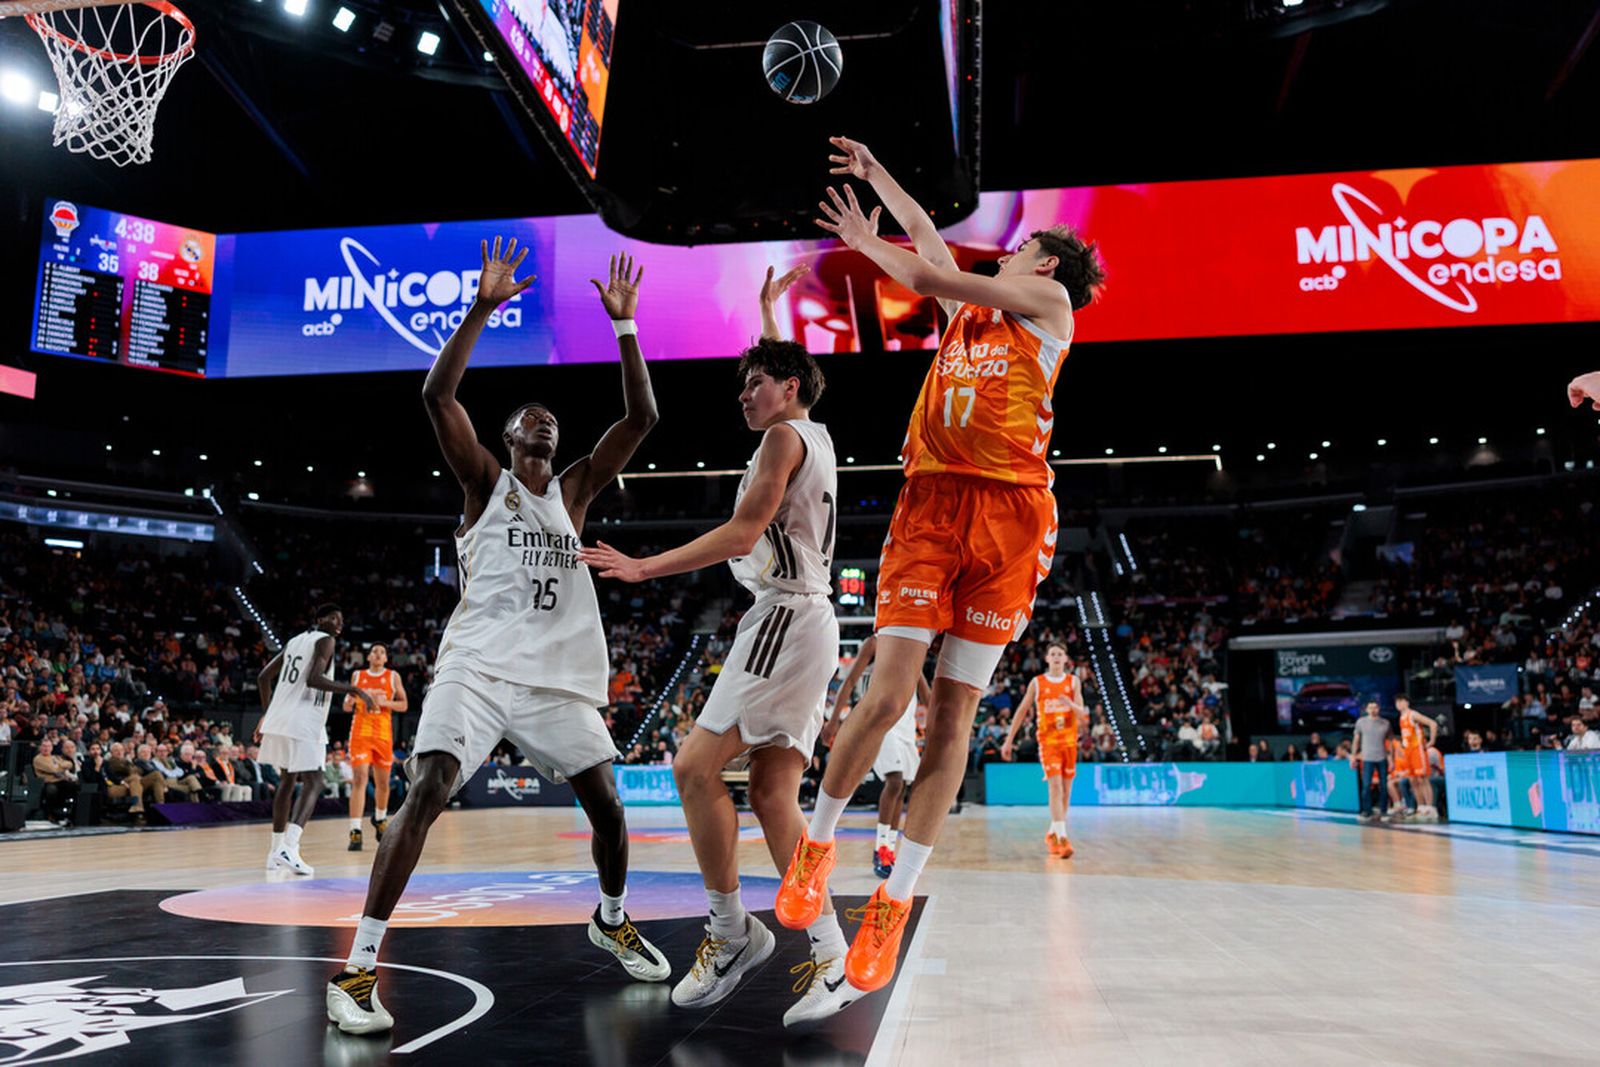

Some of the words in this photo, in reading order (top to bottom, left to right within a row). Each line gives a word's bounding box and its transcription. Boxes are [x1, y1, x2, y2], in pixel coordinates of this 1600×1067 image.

[115, 218, 155, 244] 4:38
[98, 252, 119, 273] 35
[137, 260, 159, 282] 38
[1428, 256, 1562, 286] endesa
[1300, 271, 1341, 291] acb
[303, 318, 337, 336] acb
[410, 305, 522, 332] endsa
[944, 386, 976, 428] 17
[522, 550, 541, 566] FLY
[542, 551, 578, 570] BETTER
[965, 606, 1012, 631] teika
[282, 654, 303, 684] 16
[1279, 654, 1326, 666] TOYOTA
